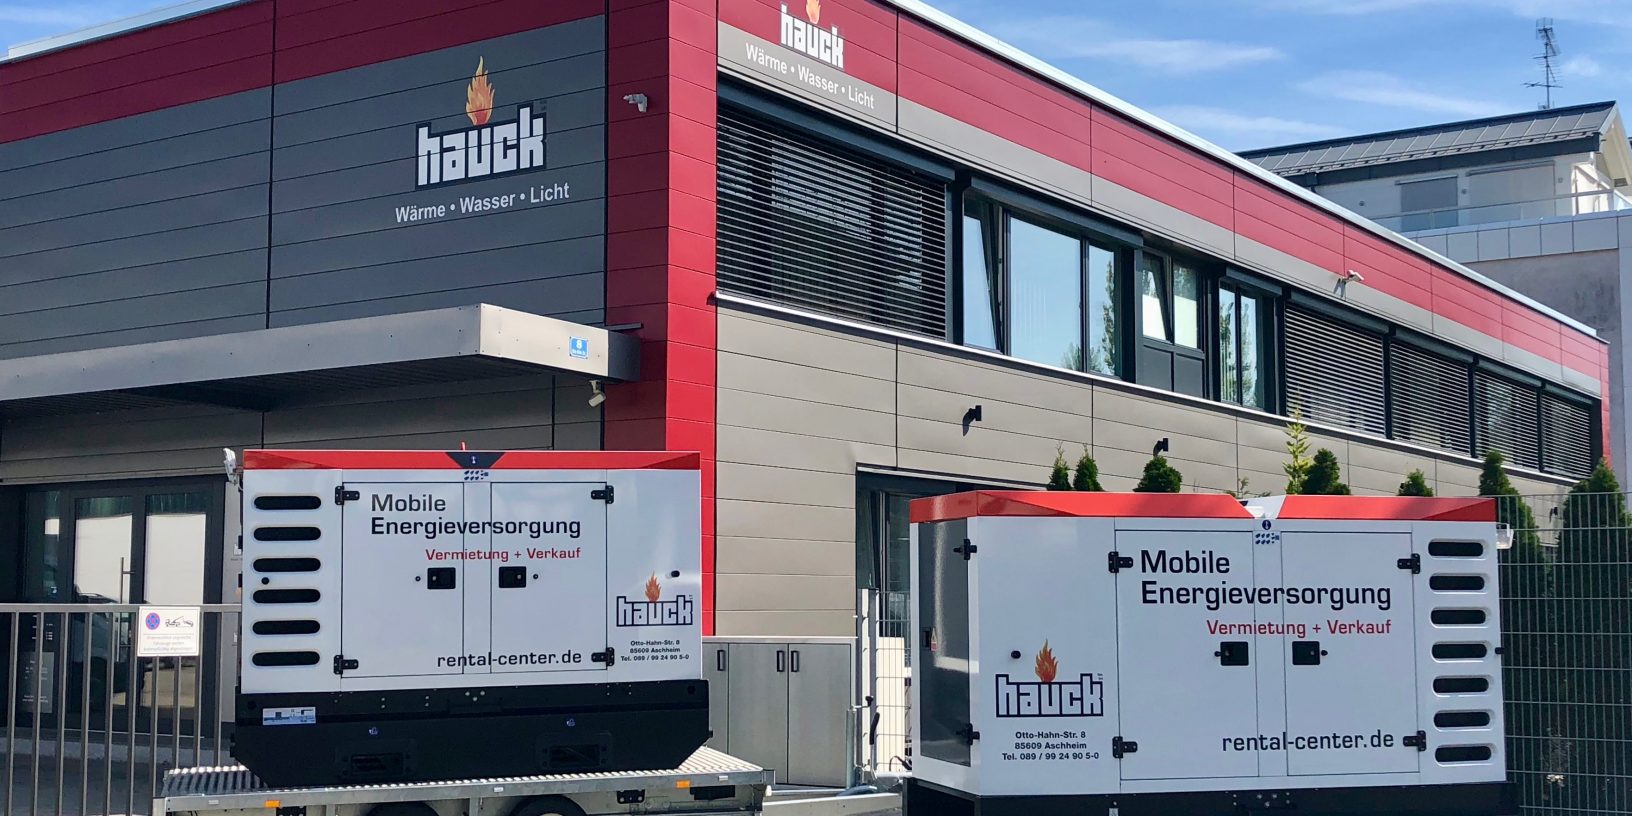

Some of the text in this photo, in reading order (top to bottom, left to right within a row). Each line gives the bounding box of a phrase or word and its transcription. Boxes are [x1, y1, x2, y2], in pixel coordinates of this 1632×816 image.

[780, 3, 844, 70] hauck
[745, 42, 875, 110] Wärme Wasser Licht
[415, 103, 547, 190] hauck
[395, 182, 570, 223] Wärme Wasser Licht
[371, 493, 446, 512] Mobile
[371, 516, 581, 540] Energieversorgung
[425, 547, 581, 563] Vermietung + Verkauf
[1140, 549, 1230, 574] Mobile
[1141, 580, 1391, 611] Energieversorgung
[616, 595, 693, 627] hauck
[1206, 619, 1392, 639] Vermietung + Verkauf
[437, 649, 582, 668] rental-center.de
[995, 673, 1104, 718] hauck
[1014, 741, 1087, 750] 85609 Aschheim
[1015, 731, 1086, 739] Otto-Hahn-Str. 8
[1222, 729, 1394, 751] rental-center.de
[1002, 752, 1100, 761] Tel. 089 / 99 24 90 5-0
